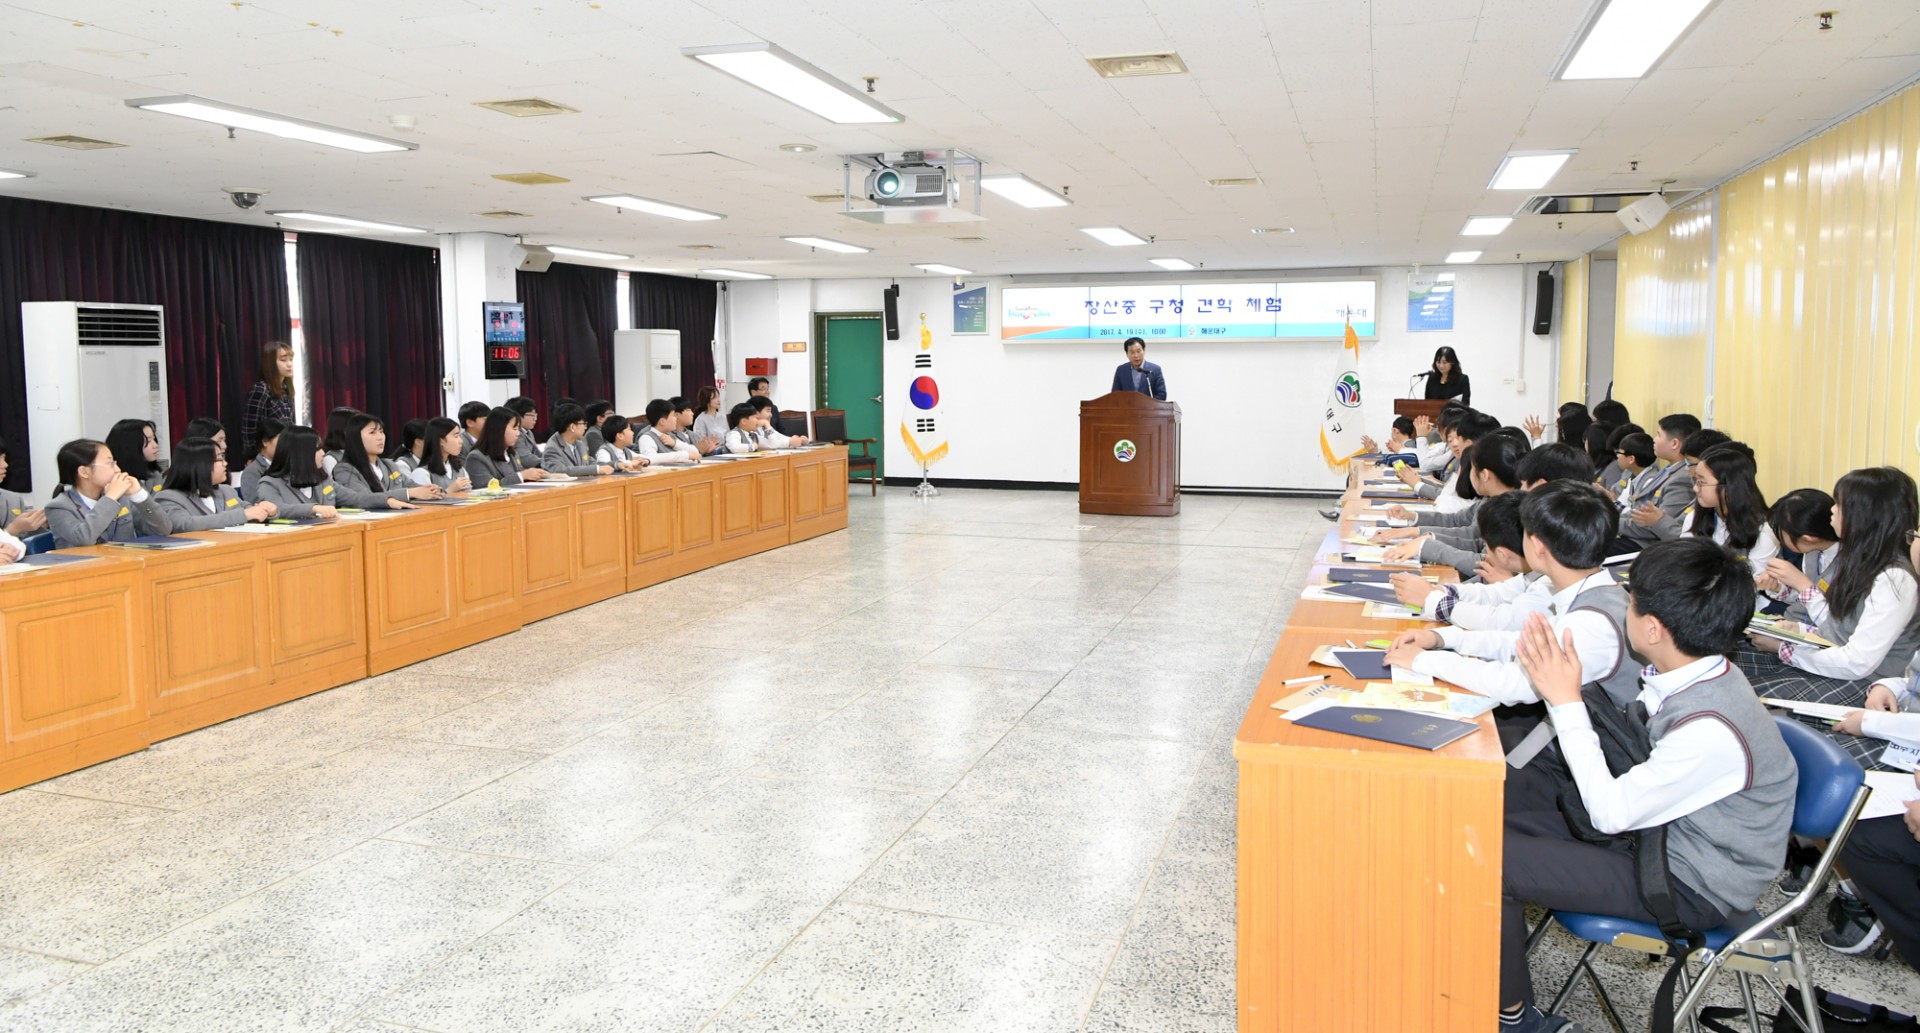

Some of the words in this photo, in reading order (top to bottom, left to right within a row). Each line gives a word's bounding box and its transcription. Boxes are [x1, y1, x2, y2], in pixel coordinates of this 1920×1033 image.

[1149, 298, 1184, 314] 구청
[1197, 298, 1233, 313] 견학
[1246, 297, 1282, 313] 체험
[494, 347, 520, 359] 11:06
